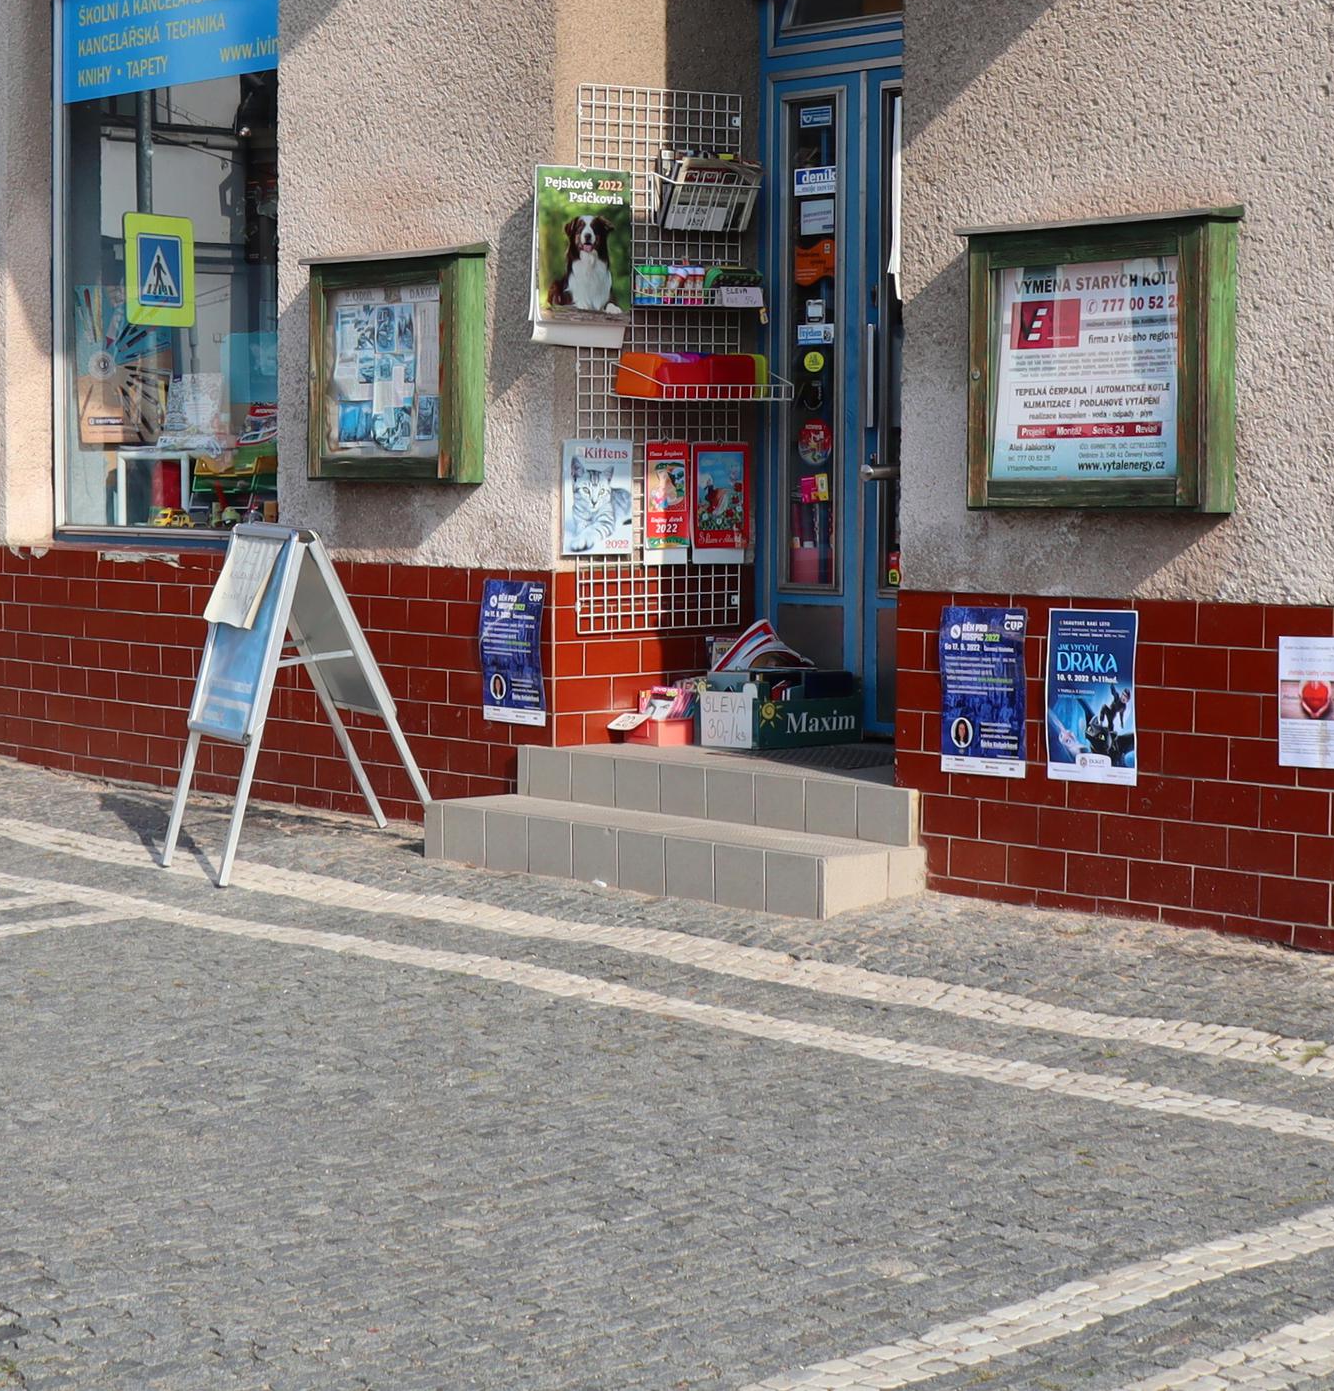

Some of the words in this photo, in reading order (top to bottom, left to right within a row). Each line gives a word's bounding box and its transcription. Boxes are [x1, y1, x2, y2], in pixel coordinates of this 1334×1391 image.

[121, 4, 130, 18] A
[78, 21, 161, 57] KANCELÁŘSKÁ
[166, 13, 227, 40] TECHNIKA
[78, 66, 112, 87] KNIHY
[126, 55, 169, 80] TAPETY
[544, 176, 593, 191] Pejskové
[597, 179, 623, 192] 2022
[802, 169, 836, 185] deník
[569, 191, 624, 206] Psíčkovia
[1015, 275, 1071, 295] VÝMĚNA
[1076, 272, 1137, 291] STARÝCH
[1102, 298, 1125, 313] 777
[1130, 297, 1144, 311] 00
[1149, 295, 1164, 309] 52
[1168, 294, 1178, 308] 2
[1088, 334, 1109, 344] firma
[1117, 332, 1147, 343] Vašeho
[1015, 384, 1047, 397] TEPELNÁ
[1049, 384, 1087, 395] ČERPADLA
[1096, 382, 1146, 394] AUTOMATICKÉ
[1023, 399, 1071, 408] KLIMATIZACE
[1079, 397, 1123, 407] PODLAHOVÉ
[1126, 395, 1160, 406] VYTÁPĚNÍ
[1021, 427, 1046, 437] Projekt
[1115, 425, 1125, 434] 24
[584, 446, 628, 459] Kittens
[1078, 459, 1165, 472] www.vytalenergy.cz
[655, 523, 678, 534] 2022
[605, 539, 629, 549] 2022
[1004, 621, 1023, 631] CUP
[1057, 652, 1118, 673] DRAKA
[1057, 673, 1066, 682] 10.
[1067, 674, 1073, 682] 9.
[1074, 674, 1089, 683] 2022
[703, 694, 747, 715] SLEVA
[786, 709, 856, 734] Maxim
